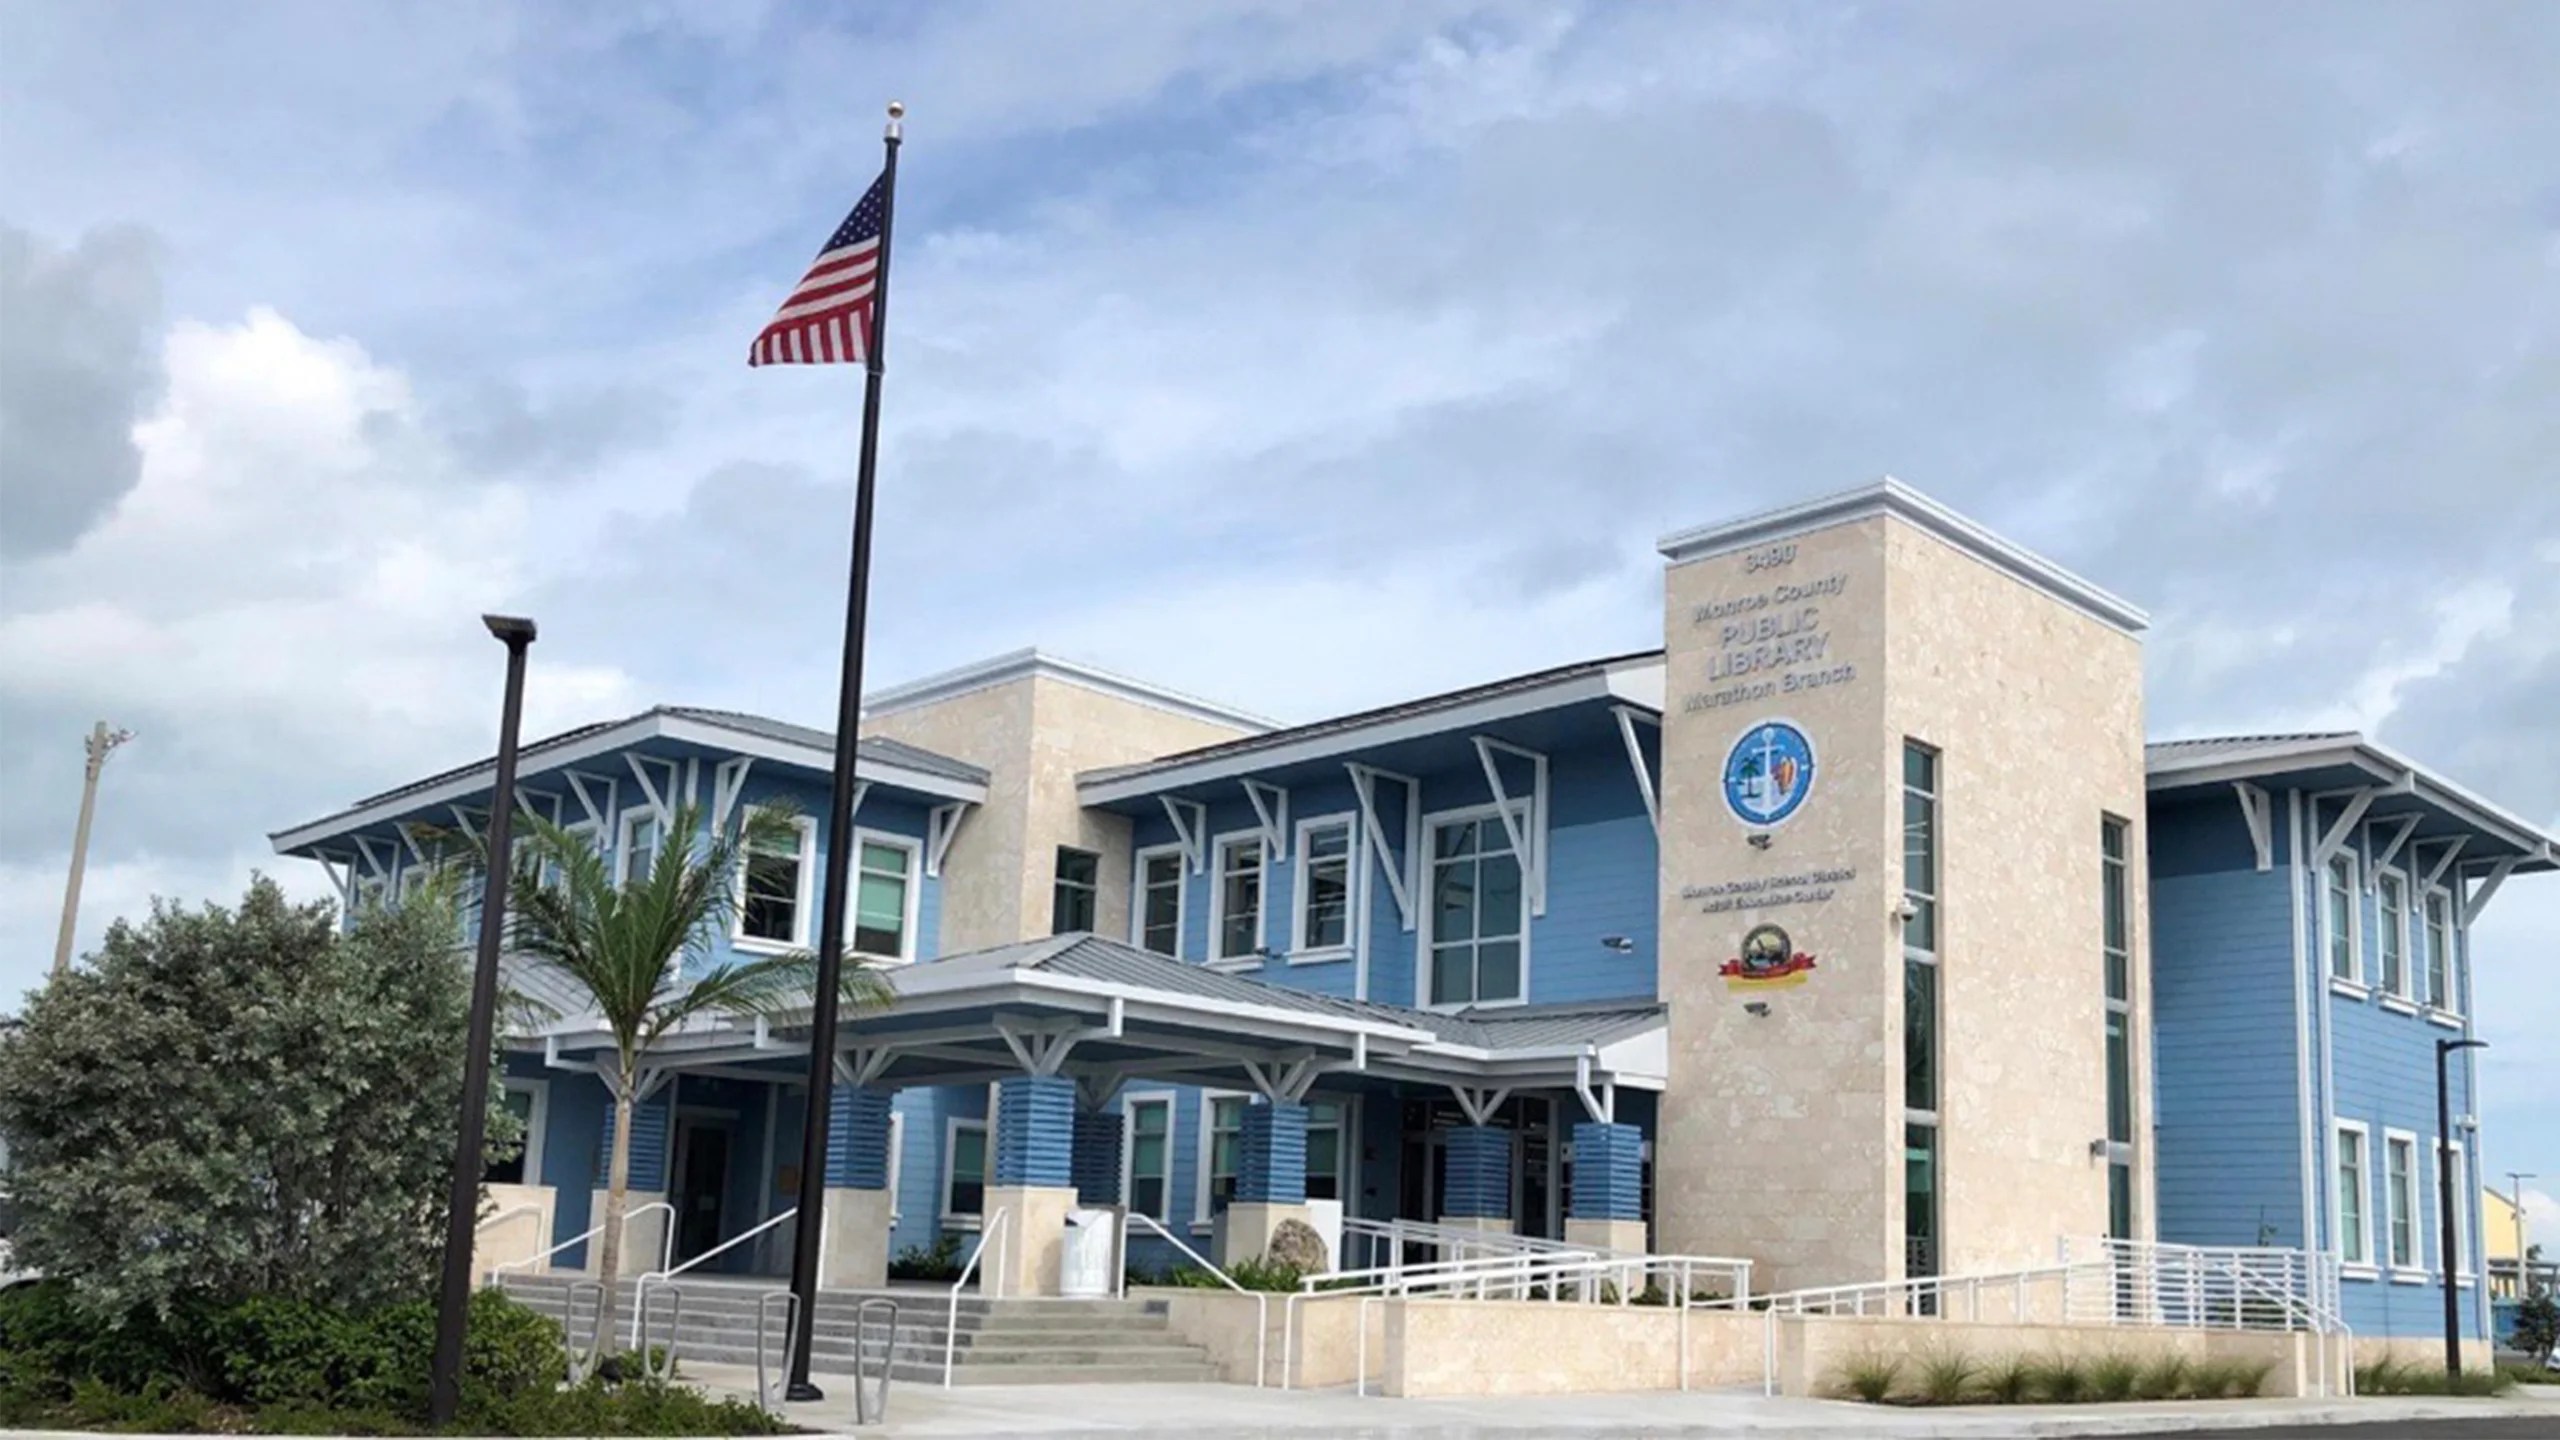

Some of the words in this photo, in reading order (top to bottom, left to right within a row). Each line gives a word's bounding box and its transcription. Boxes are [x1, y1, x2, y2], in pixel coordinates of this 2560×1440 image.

[1694, 592, 1769, 624] Monroe
[1773, 572, 1849, 605] County
[1720, 607, 1820, 650] PUBLIC
[1706, 630, 1831, 682] LIBRARY
[1684, 679, 1778, 714] Marathon
[1781, 660, 1858, 695] Branch
